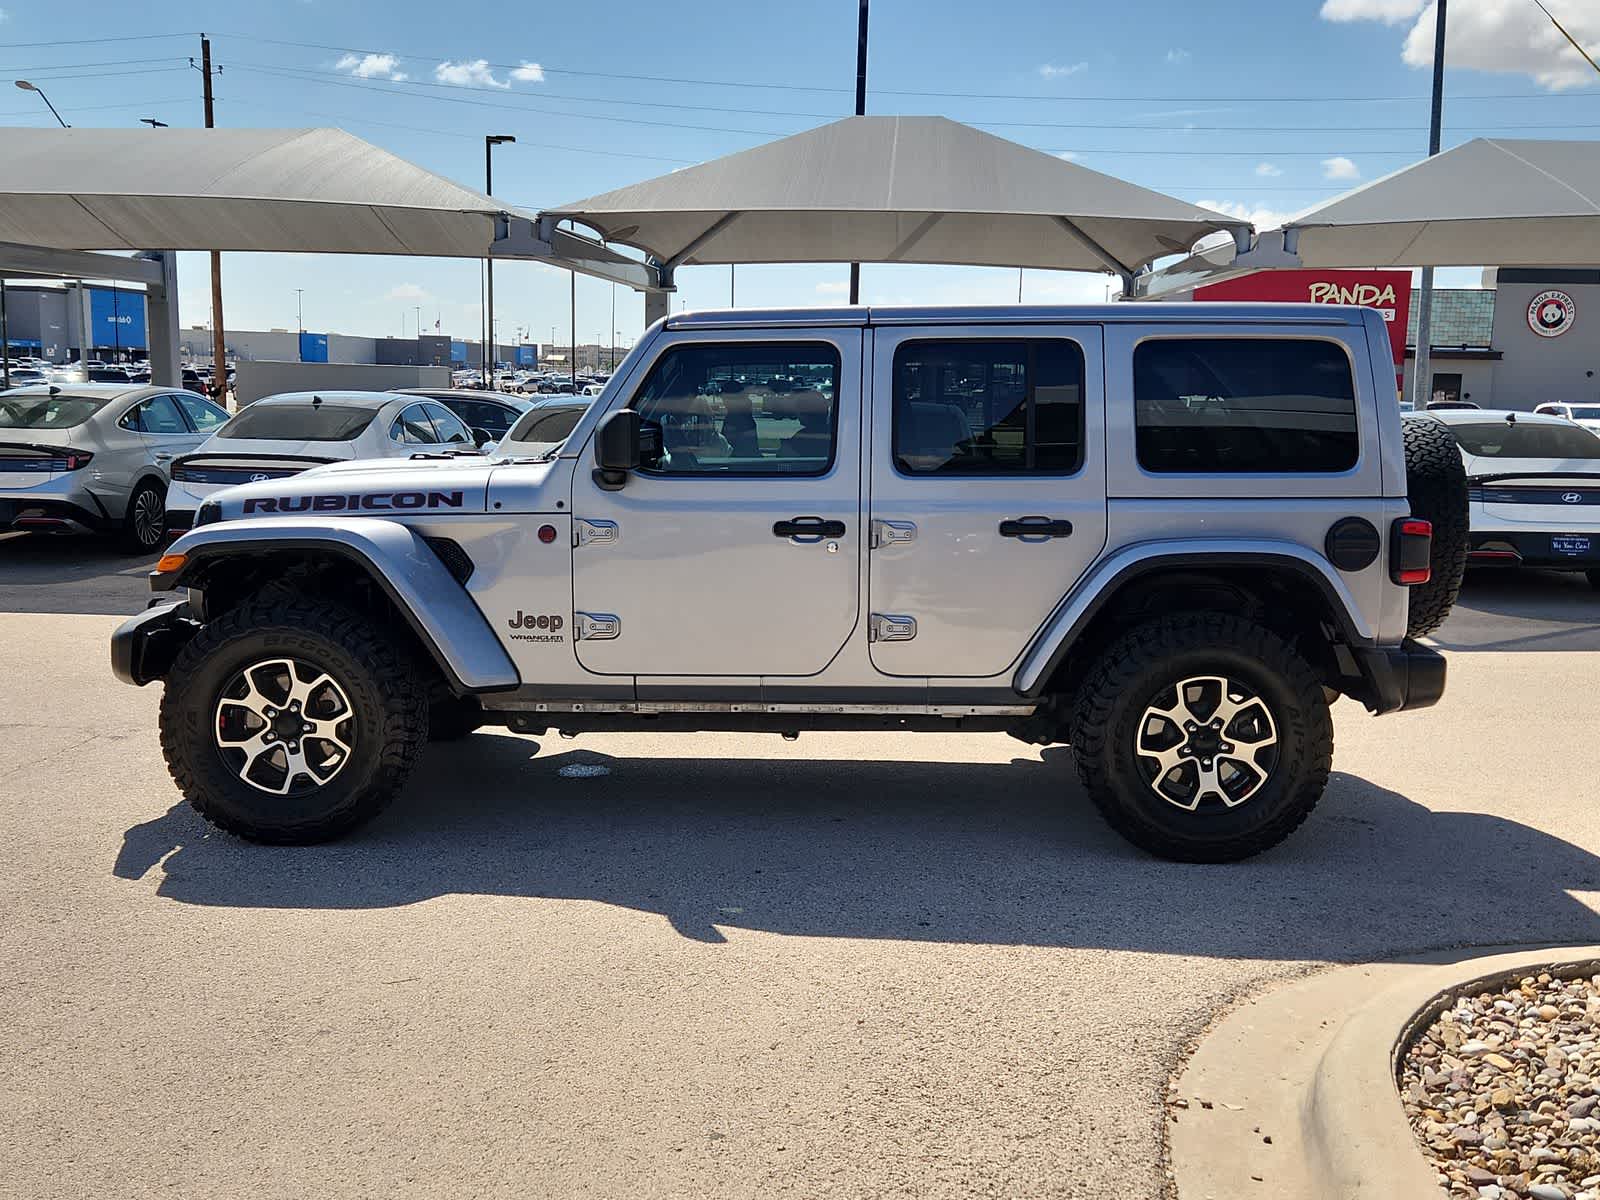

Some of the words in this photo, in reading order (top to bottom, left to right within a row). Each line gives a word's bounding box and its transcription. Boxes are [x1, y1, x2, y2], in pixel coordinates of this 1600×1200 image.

[1308, 282, 1396, 305] PANDA
[1530, 294, 1549, 315] PANDA
[1551, 292, 1574, 315] EXPRESS
[243, 491, 464, 514] RUBICON
[508, 611, 563, 632] Jeep
